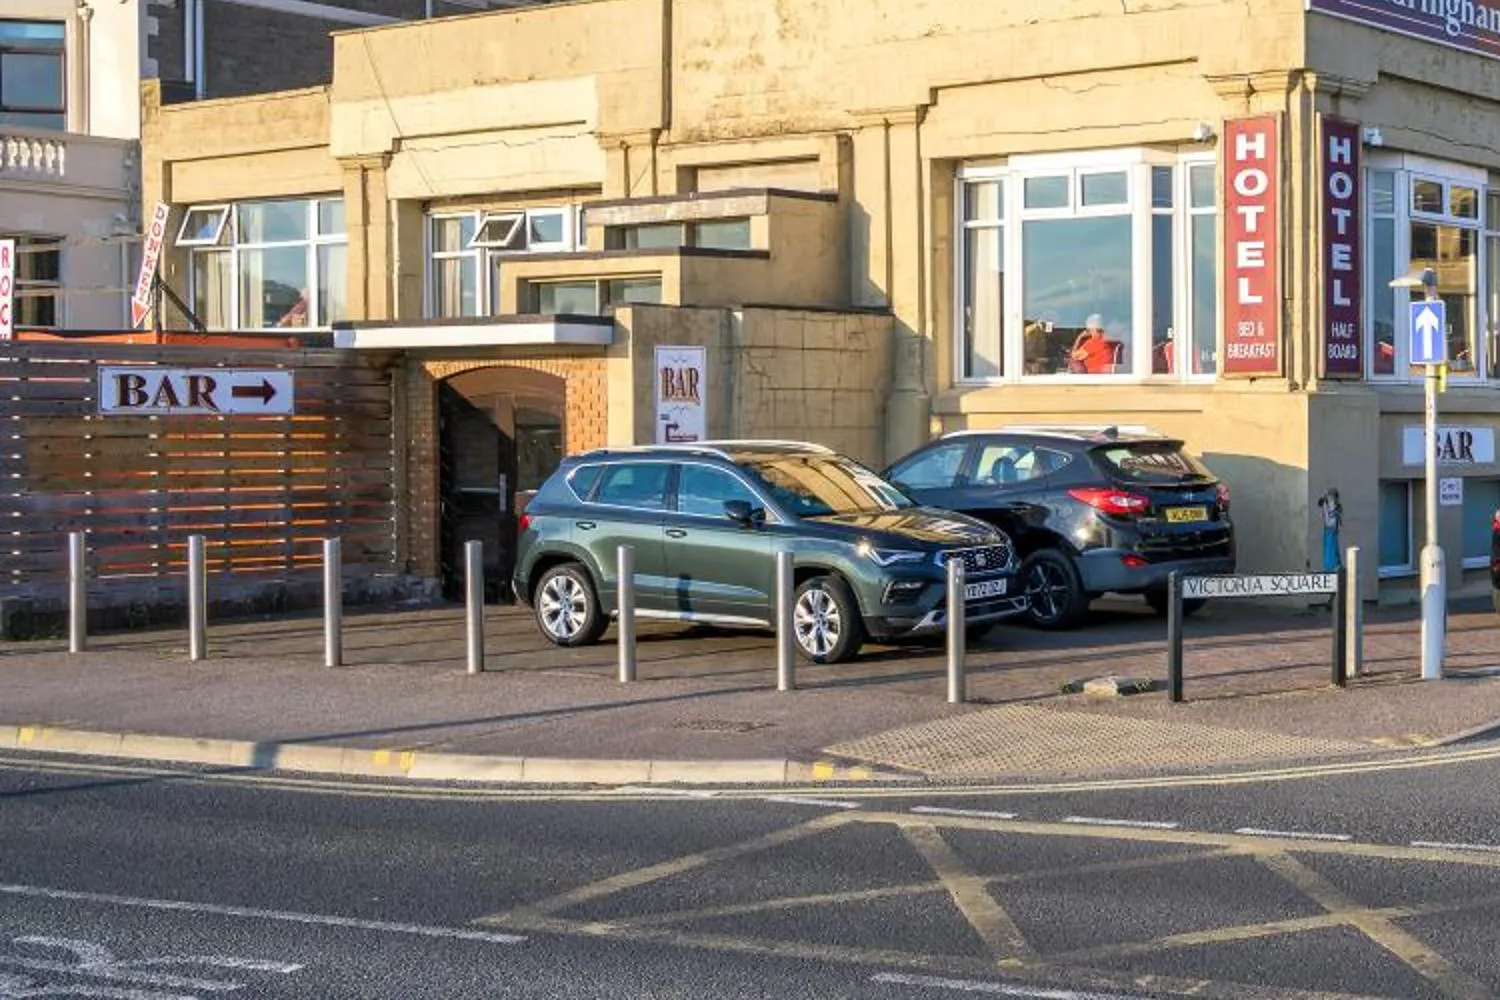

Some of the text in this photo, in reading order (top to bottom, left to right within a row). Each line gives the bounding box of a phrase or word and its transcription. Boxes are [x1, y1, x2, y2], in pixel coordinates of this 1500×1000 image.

[1233, 132, 1269, 305] HOTEL
[1329, 135, 1353, 306] HOTEL
[112, 373, 220, 413] BAR
[661, 367, 700, 405] BAR
[1187, 574, 1332, 594] VICTORIA SQUARE
